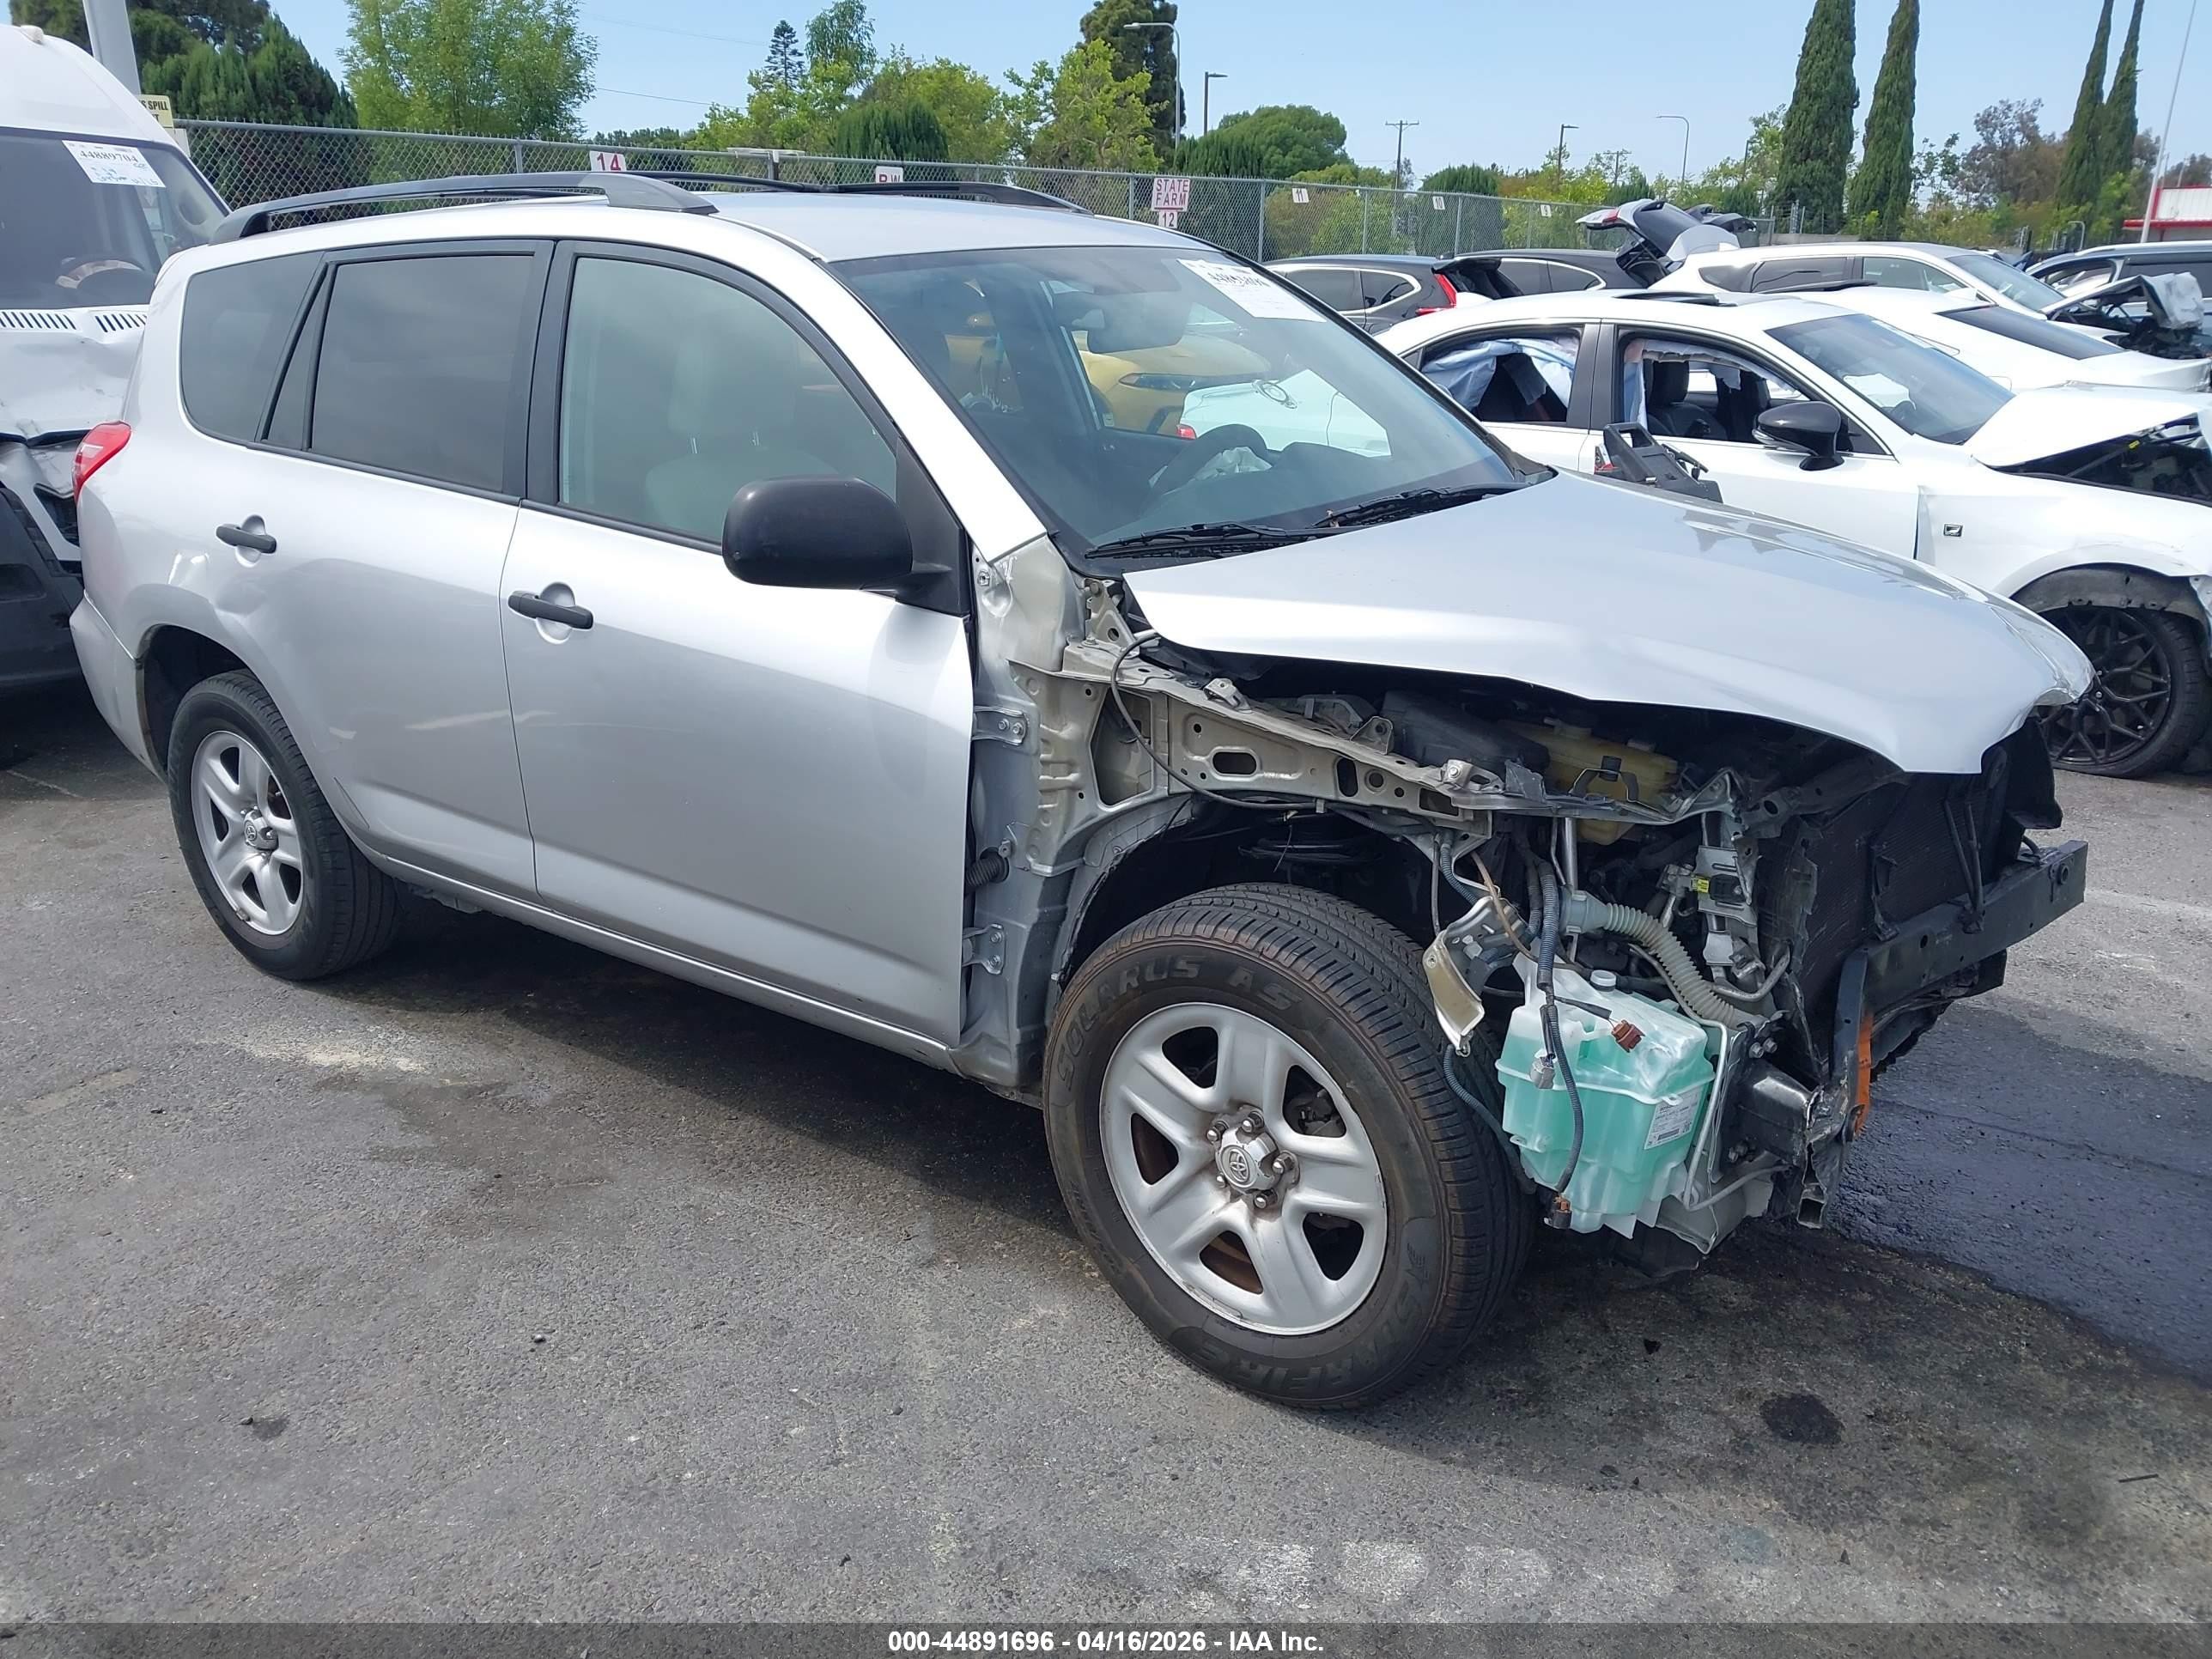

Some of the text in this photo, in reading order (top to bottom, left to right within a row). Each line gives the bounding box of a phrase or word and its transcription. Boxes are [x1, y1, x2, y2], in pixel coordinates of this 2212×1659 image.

[148, 100, 168, 110] SPILL
[597, 152, 621, 171] 14
[1156, 179, 1189, 193] STATE
[1155, 192, 1187, 206] FARM
[1296, 188, 1304, 202] 11
[1435, 197, 1443, 210] 10
[1162, 212, 1175, 228] 12
[1057, 954, 1304, 1092] SOLARUS AS
